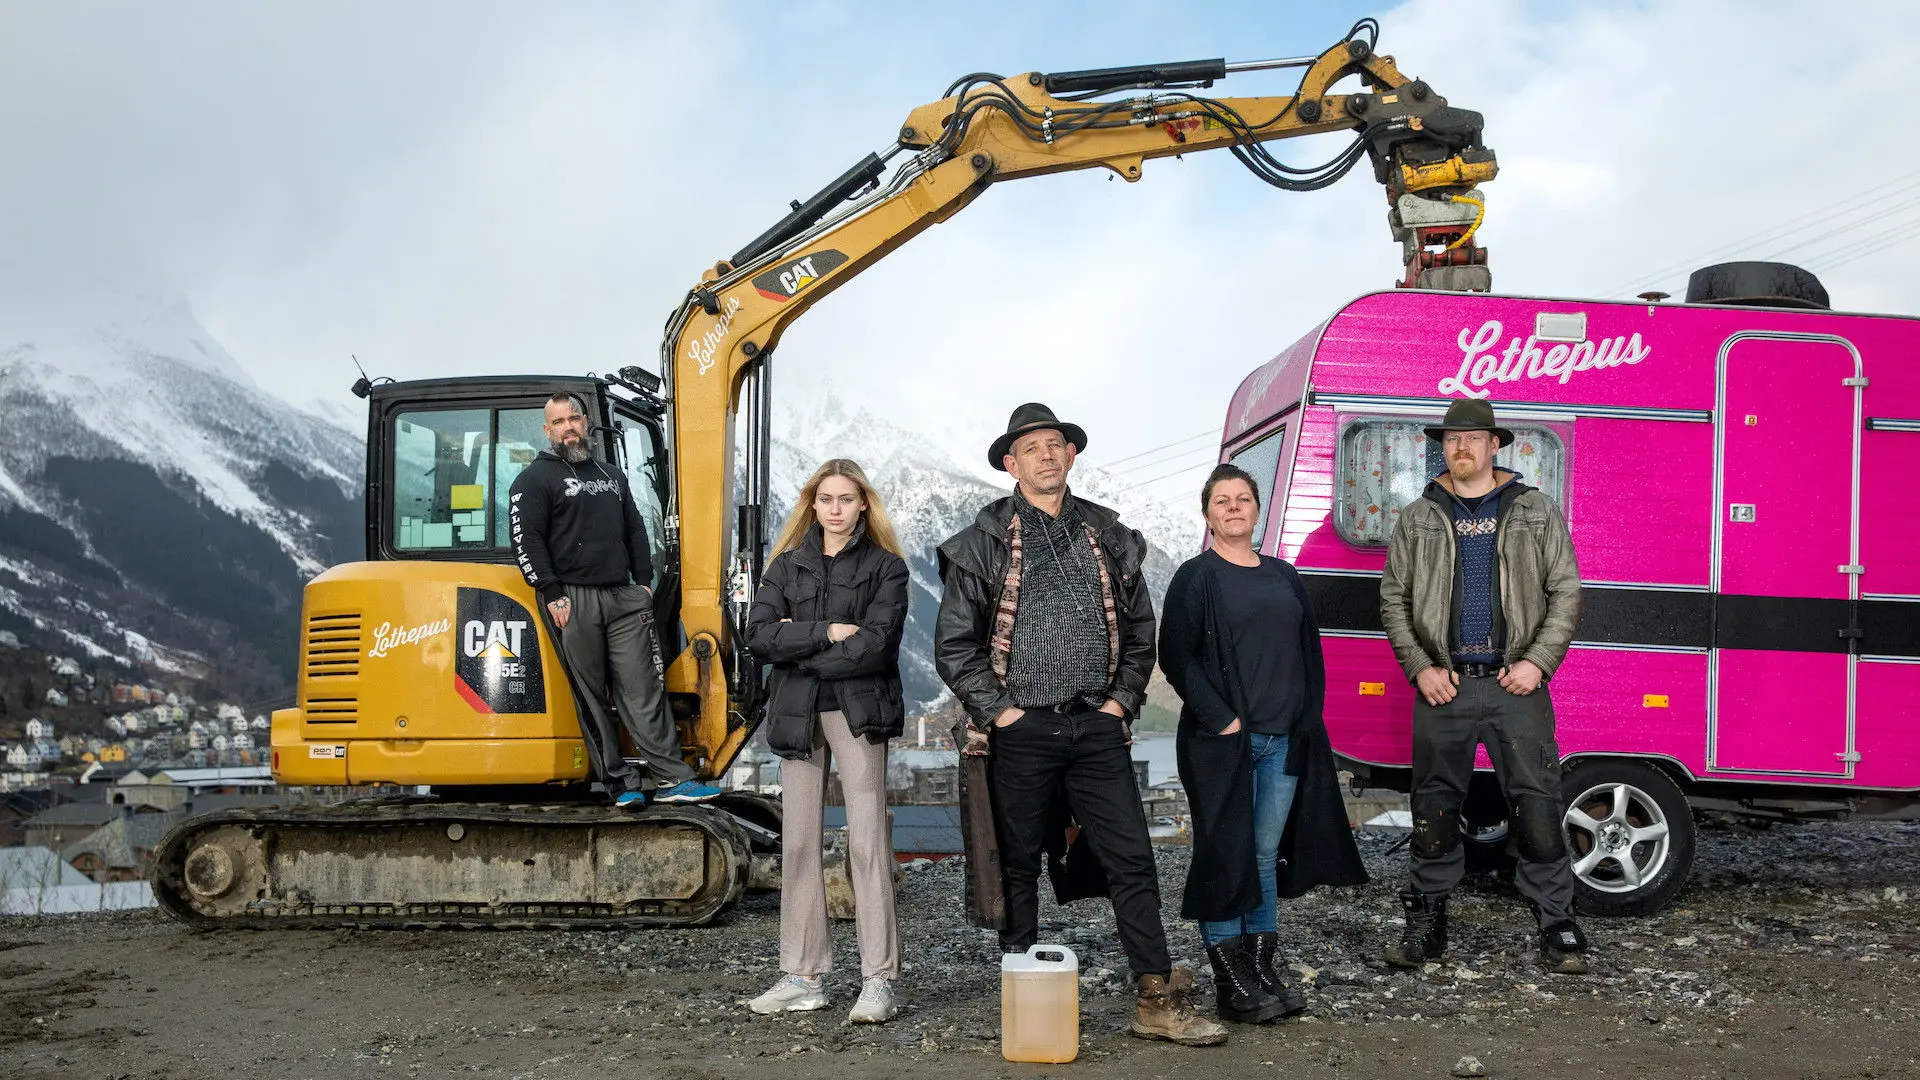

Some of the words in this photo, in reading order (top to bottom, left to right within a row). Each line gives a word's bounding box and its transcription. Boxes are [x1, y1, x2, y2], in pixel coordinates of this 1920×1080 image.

[779, 257, 819, 294] CAT
[688, 296, 740, 375] Lothepus
[1438, 320, 1651, 399] Lothepus
[510, 492, 538, 583] WALSVIKEN
[368, 618, 452, 658] Lothepus
[464, 620, 527, 658] CAT
[484, 663, 526, 678] 35E2
[509, 681, 525, 694] CR
